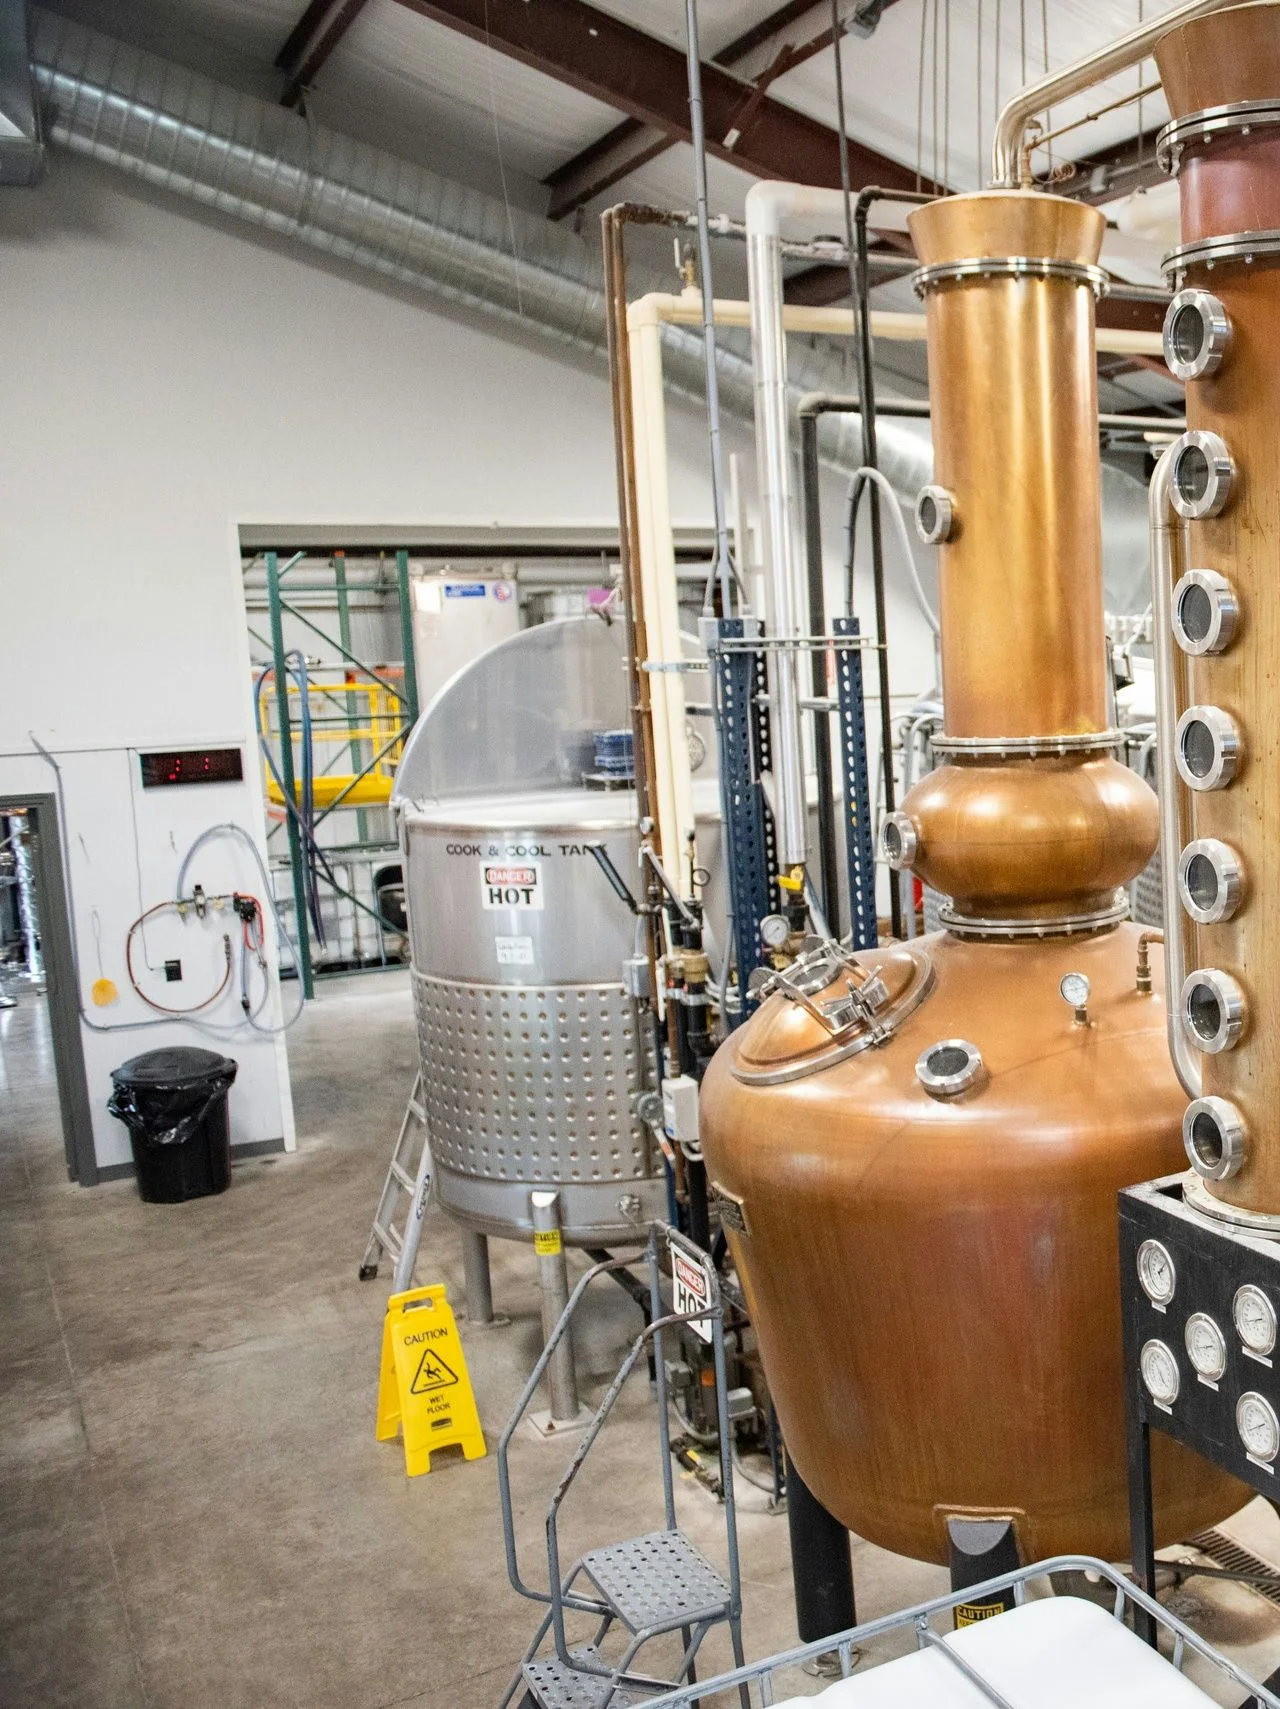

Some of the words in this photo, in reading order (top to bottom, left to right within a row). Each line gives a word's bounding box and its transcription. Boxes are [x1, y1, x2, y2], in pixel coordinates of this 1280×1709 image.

[446, 844, 481, 856] COOK
[488, 845, 499, 856] &
[505, 844, 551, 856] COOL
[489, 869, 534, 883] DANGER
[489, 887, 534, 905] HOT
[404, 1327, 448, 1346] CAUTION
[429, 1394, 444, 1404] WET
[427, 1402, 450, 1414] FLOOR
[958, 1605, 1001, 1619] CAUTION
